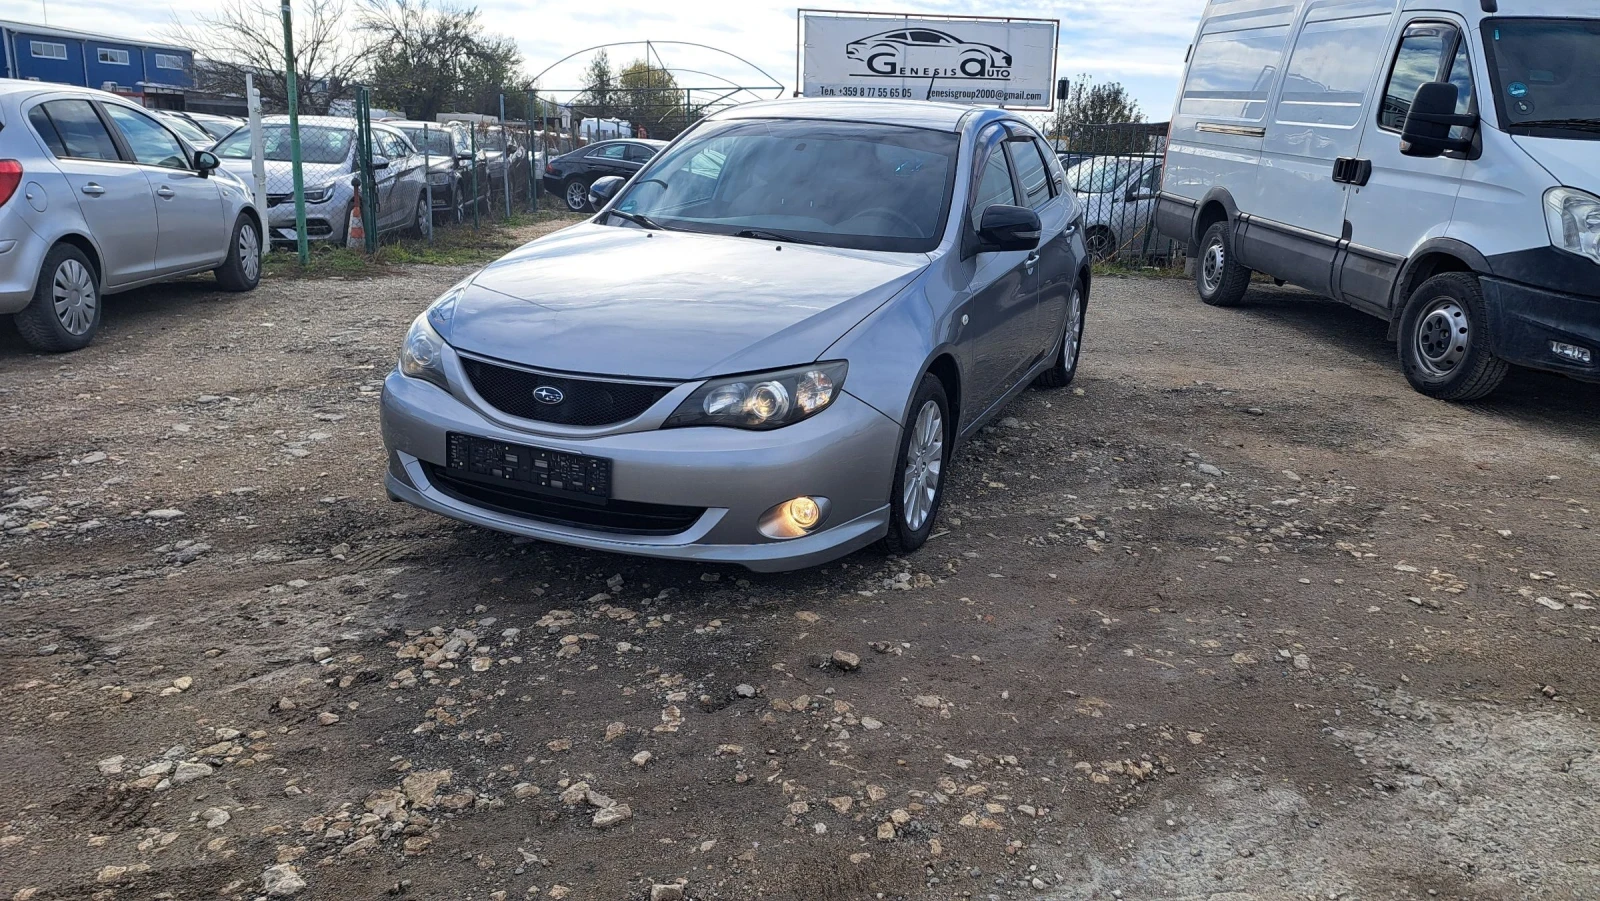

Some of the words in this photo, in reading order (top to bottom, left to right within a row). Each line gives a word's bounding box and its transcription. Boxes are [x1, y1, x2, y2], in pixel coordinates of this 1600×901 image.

[820, 86, 836, 96] Тел.
[838, 86, 857, 97] +359
[859, 87, 865, 97] 8
[867, 87, 875, 97] 77
[877, 88, 887, 98] 55
[890, 88, 900, 98] 65
[902, 88, 912, 98] 05
